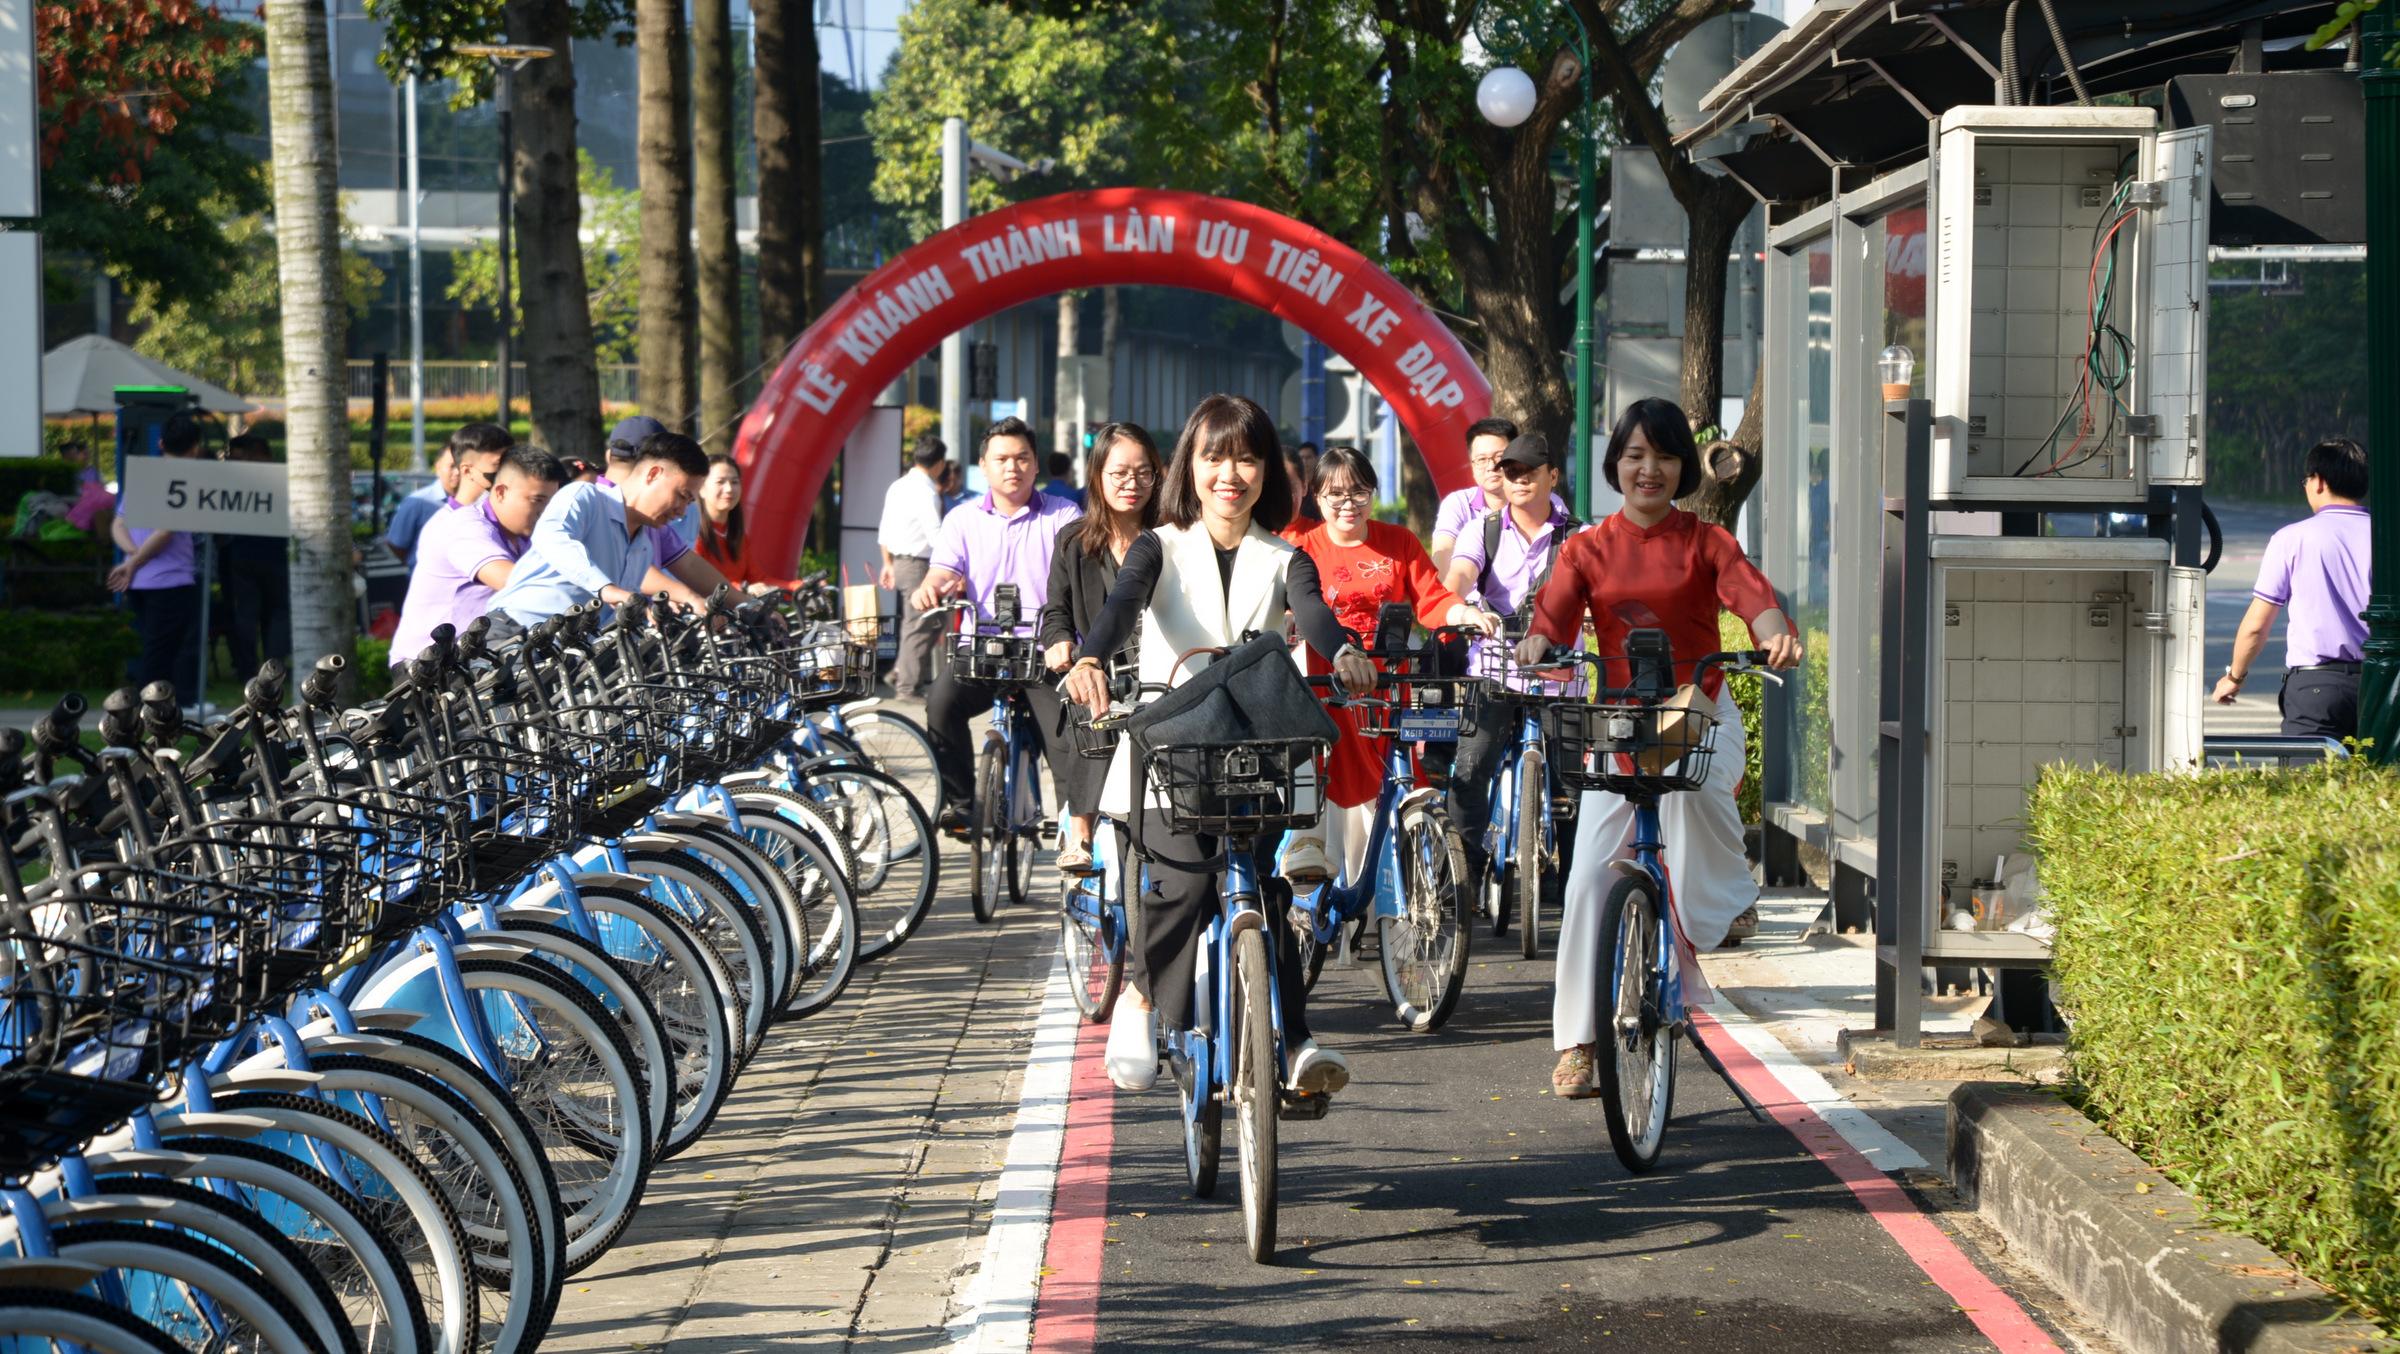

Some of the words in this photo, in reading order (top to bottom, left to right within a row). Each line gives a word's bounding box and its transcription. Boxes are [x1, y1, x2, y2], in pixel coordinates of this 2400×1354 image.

[836, 265, 954, 366] KHÁNH
[960, 218, 1082, 283] THÀNH
[1103, 207, 1175, 254] LÀN
[1196, 219, 1250, 265] ƯU
[1264, 239, 1344, 306] TIÊN
[1345, 291, 1402, 347] XE
[1395, 340, 1464, 408] ĐẠP
[167, 480, 188, 509] 5
[198, 489, 273, 513] KM/H
